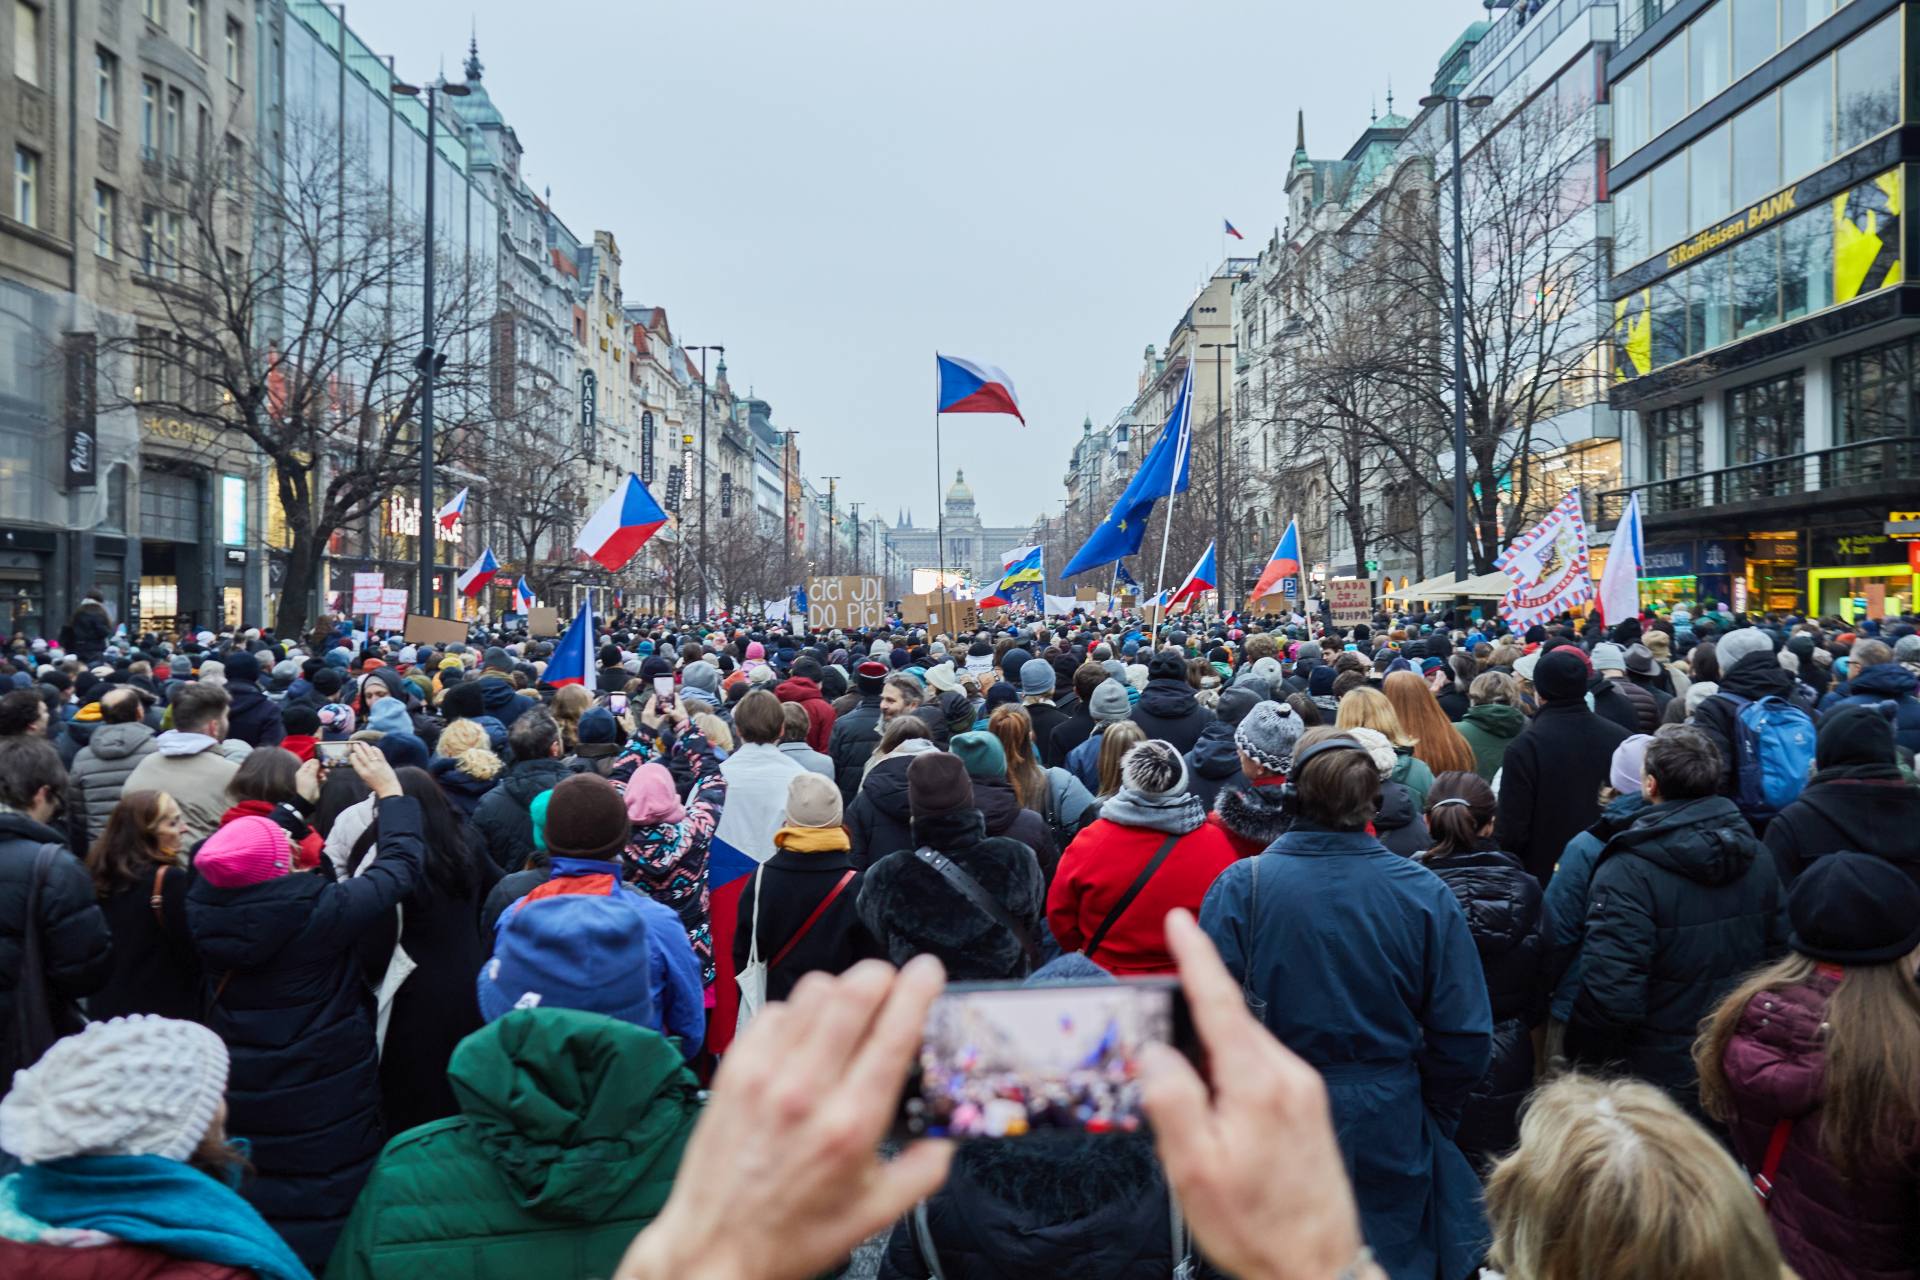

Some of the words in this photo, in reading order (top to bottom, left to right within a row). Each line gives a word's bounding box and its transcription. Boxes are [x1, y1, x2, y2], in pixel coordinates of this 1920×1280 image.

[1678, 218, 1745, 263] Raiffeisen
[1747, 186, 1798, 229] BANK
[583, 374, 593, 451] CASINO
[808, 577, 843, 602] ČIČI
[851, 577, 882, 602] JDI
[1285, 580, 1294, 592] P
[809, 603, 837, 628] DO
[847, 601, 884, 628] PIČI
